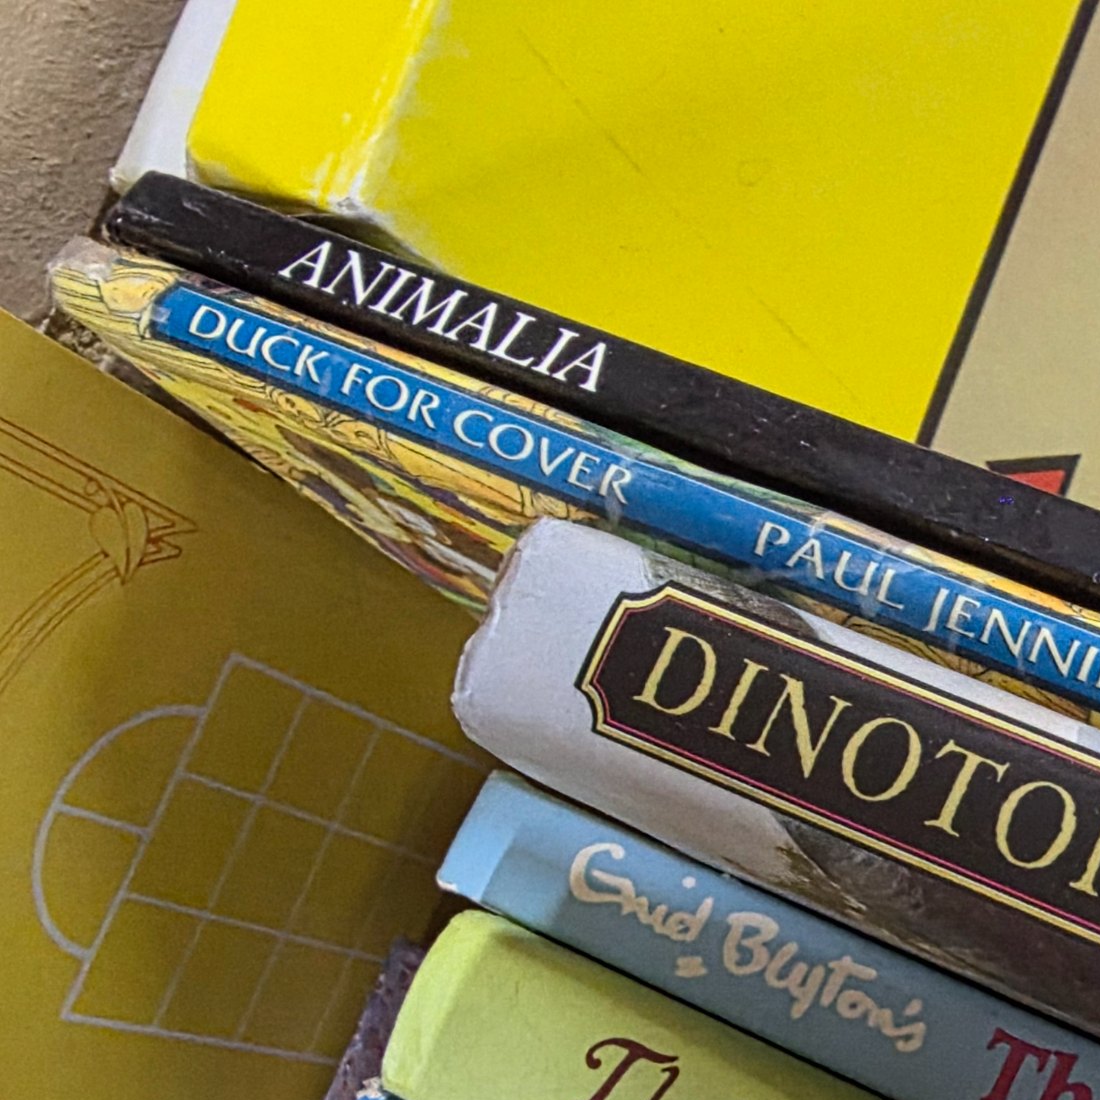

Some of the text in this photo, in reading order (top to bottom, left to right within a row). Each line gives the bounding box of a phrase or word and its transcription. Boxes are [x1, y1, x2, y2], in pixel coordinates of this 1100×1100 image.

[278, 240, 609, 393] ANIMALIA
[187, 305, 634, 505] DUCK FOR COVER
[753, 521, 906, 609] PAUL
[568, 841, 930, 1054] Enid Blyton's
